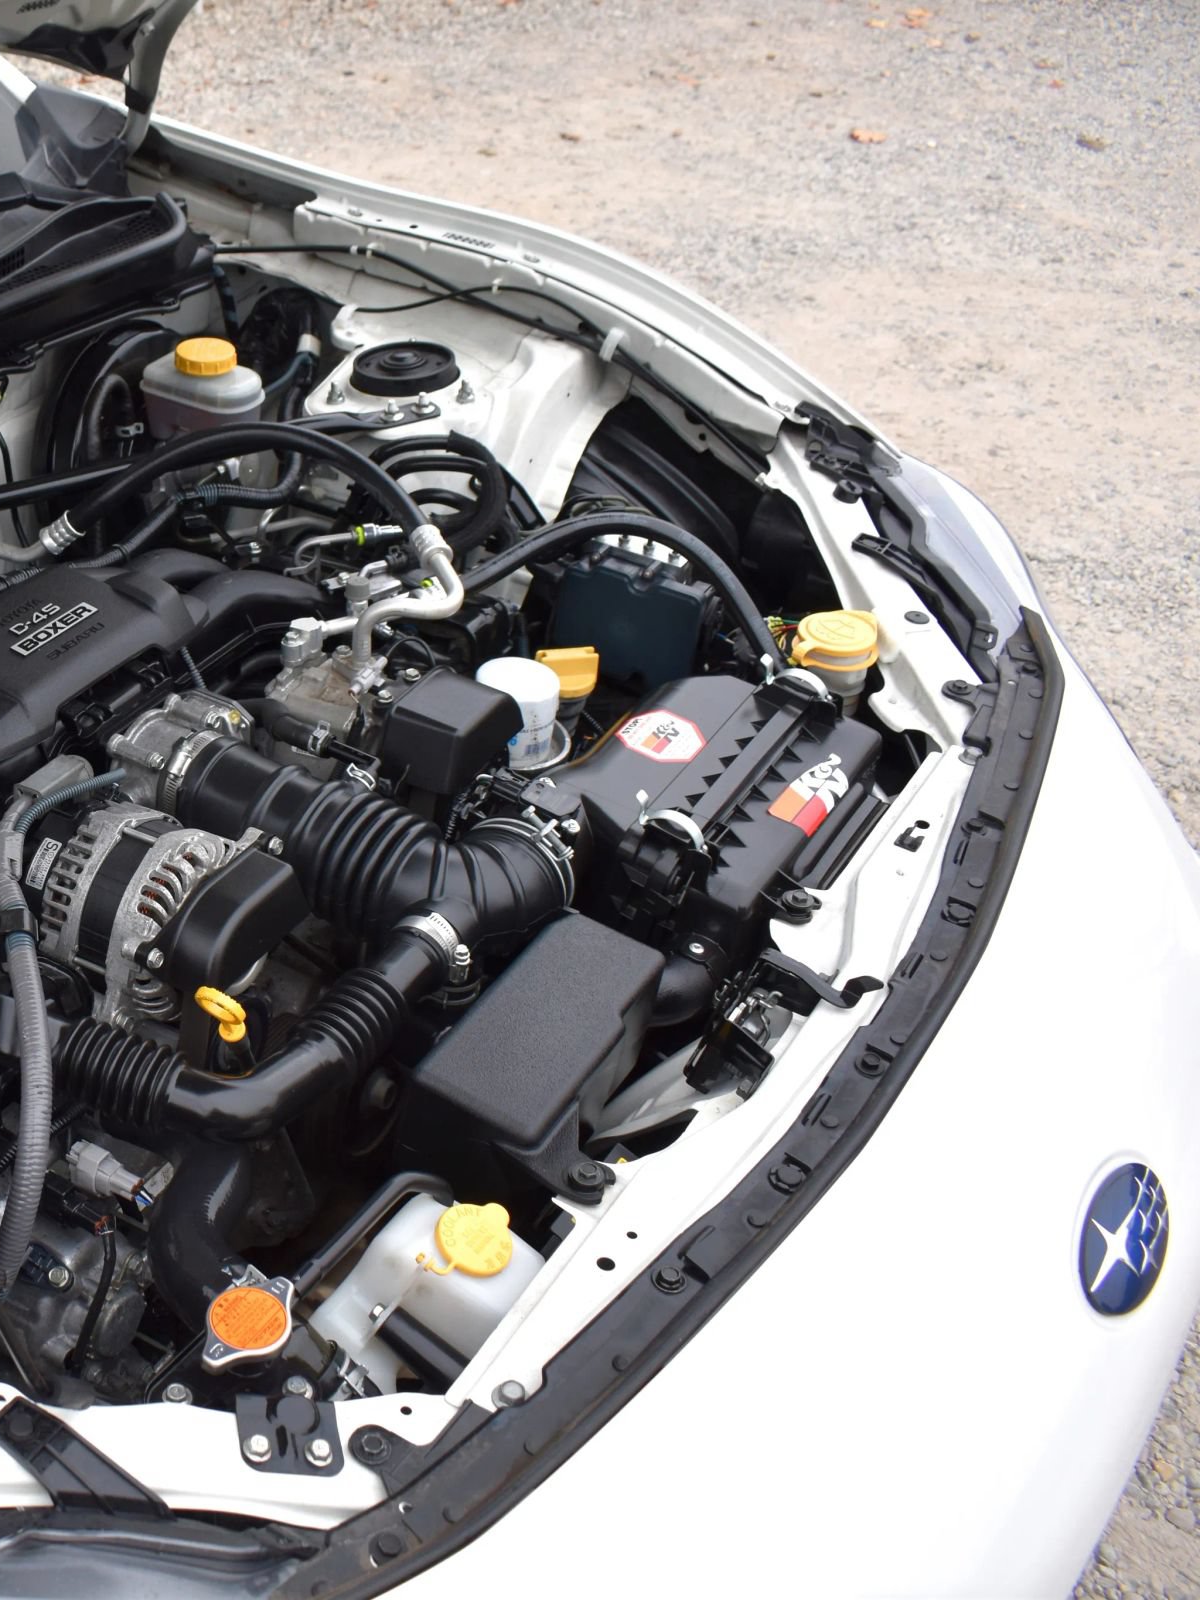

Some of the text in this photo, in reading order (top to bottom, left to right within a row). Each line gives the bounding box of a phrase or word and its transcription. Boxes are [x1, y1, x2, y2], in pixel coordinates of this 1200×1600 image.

[9, 603, 61, 636] D-4S
[17, 605, 93, 652] BOXER
[46, 622, 105, 661] SUBARU
[442, 1206, 481, 1248] COOLANT
